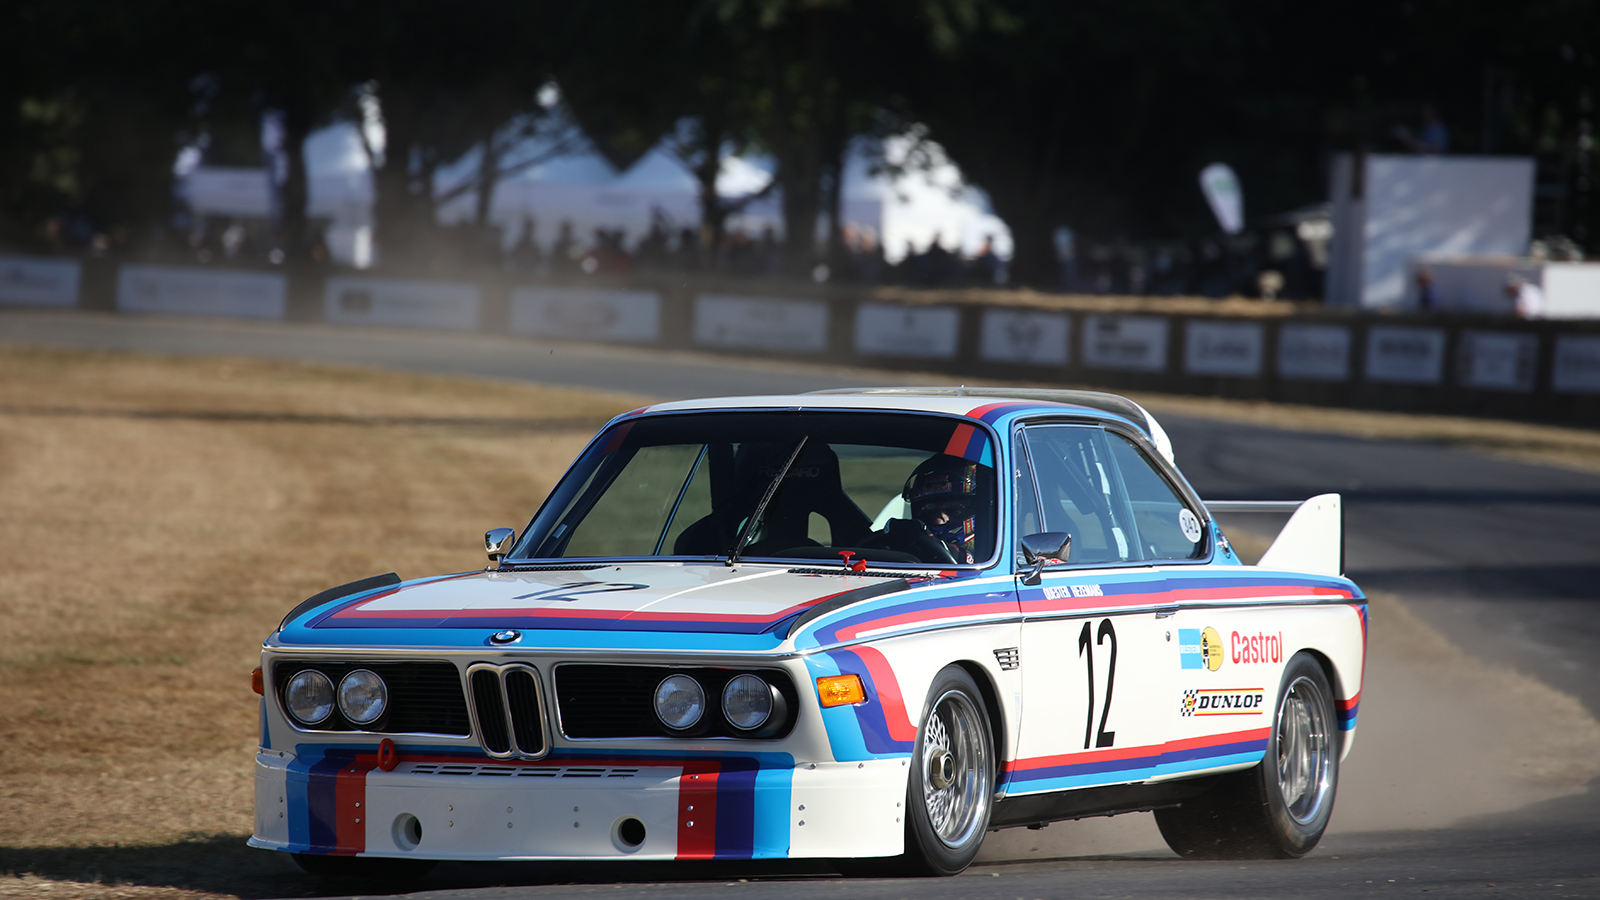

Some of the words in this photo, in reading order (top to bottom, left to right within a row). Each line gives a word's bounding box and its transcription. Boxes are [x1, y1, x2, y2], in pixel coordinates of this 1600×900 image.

[511, 581, 650, 602] 12
[1042, 586, 1071, 601] QUESTER
[1070, 584, 1104, 598] HEZEMANS
[1231, 630, 1283, 664] Castrol
[1078, 618, 1117, 749] 12
[1198, 694, 1263, 709] DUNLOP
